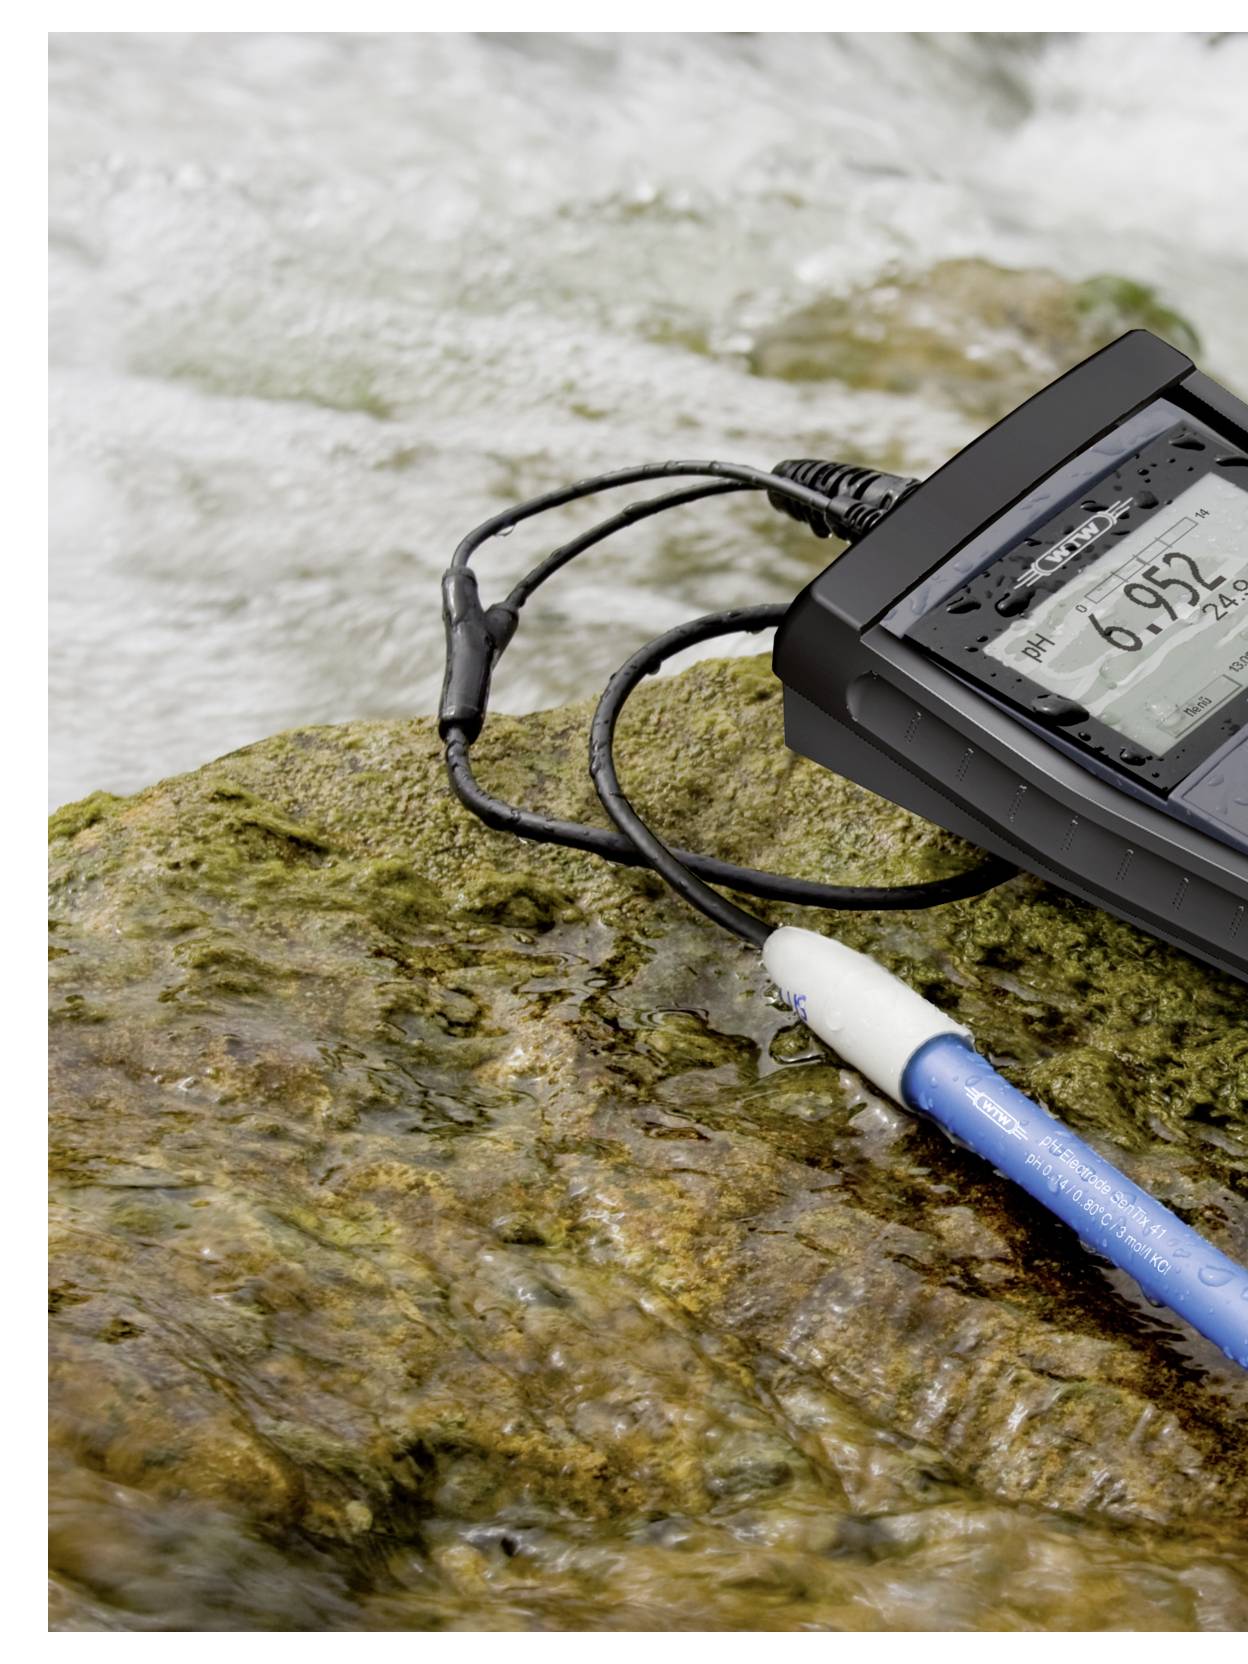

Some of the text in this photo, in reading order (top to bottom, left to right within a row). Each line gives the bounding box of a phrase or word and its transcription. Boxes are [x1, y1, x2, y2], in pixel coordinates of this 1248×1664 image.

[1195, 508, 1210, 520] 14
[1045, 521, 1101, 564] WTW
[1088, 552, 1226, 652] 6.952
[1021, 633, 1055, 663] pH
[1183, 696, 1212, 717] Menü
[982, 1099, 1010, 1126] WTW
[1025, 1153, 1042, 1172] pH
[1116, 1226, 1126, 1239] 3
[1039, 1135, 1167, 1240] pH-Electrode SenTix 41
